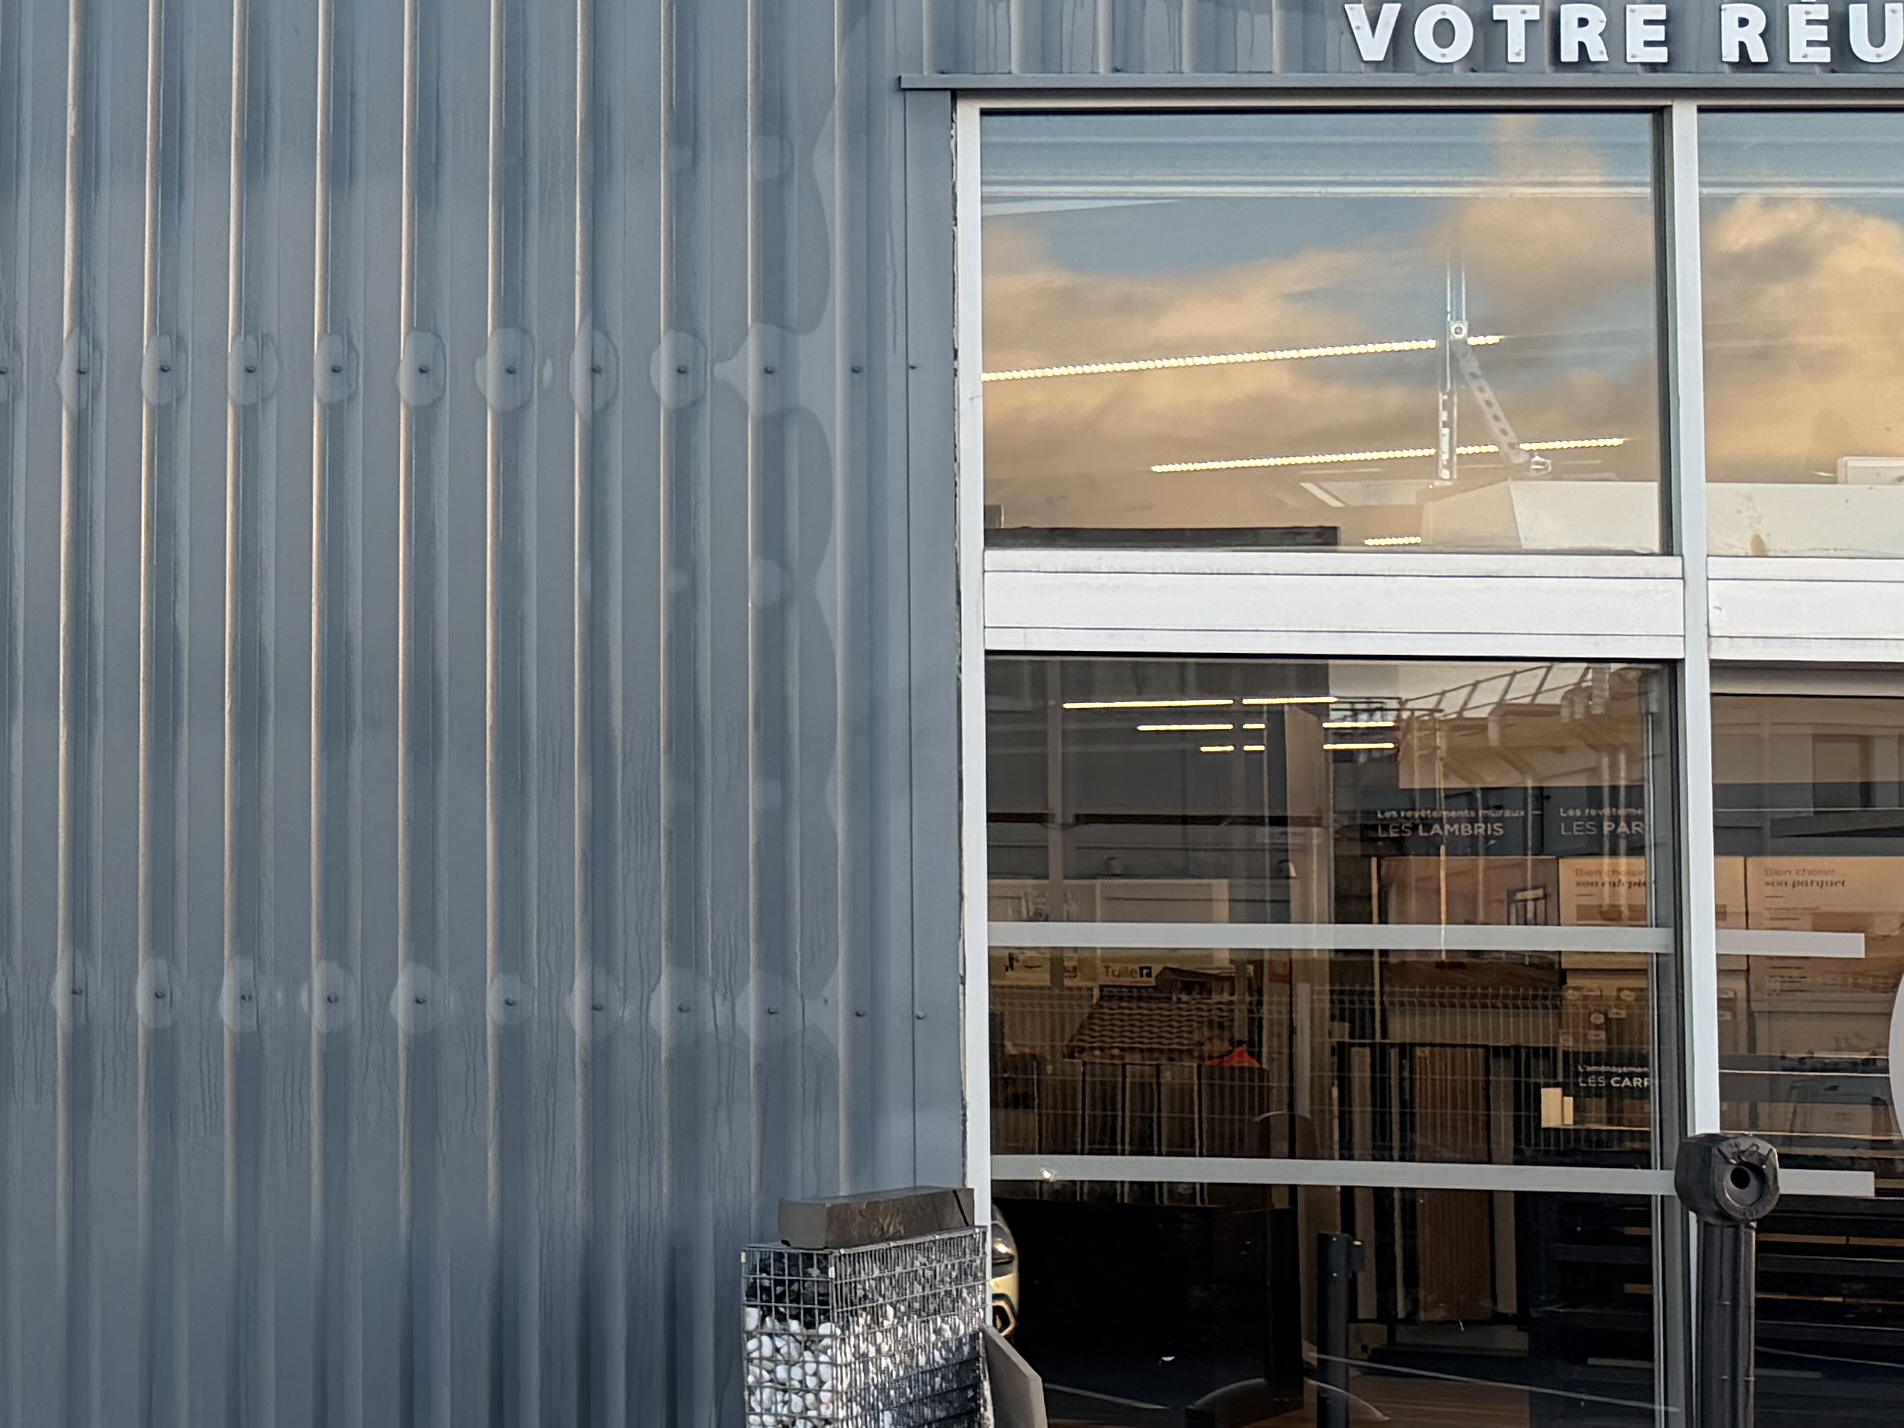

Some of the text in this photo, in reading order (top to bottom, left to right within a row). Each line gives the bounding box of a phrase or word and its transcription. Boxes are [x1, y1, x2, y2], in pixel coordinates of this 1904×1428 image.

[1343, 2, 1669, 63] VOTRE
[1377, 822, 1505, 837] LES LAMBRIS
[1560, 821, 1598, 836] LES
[1577, 1074, 1606, 1087] LES
